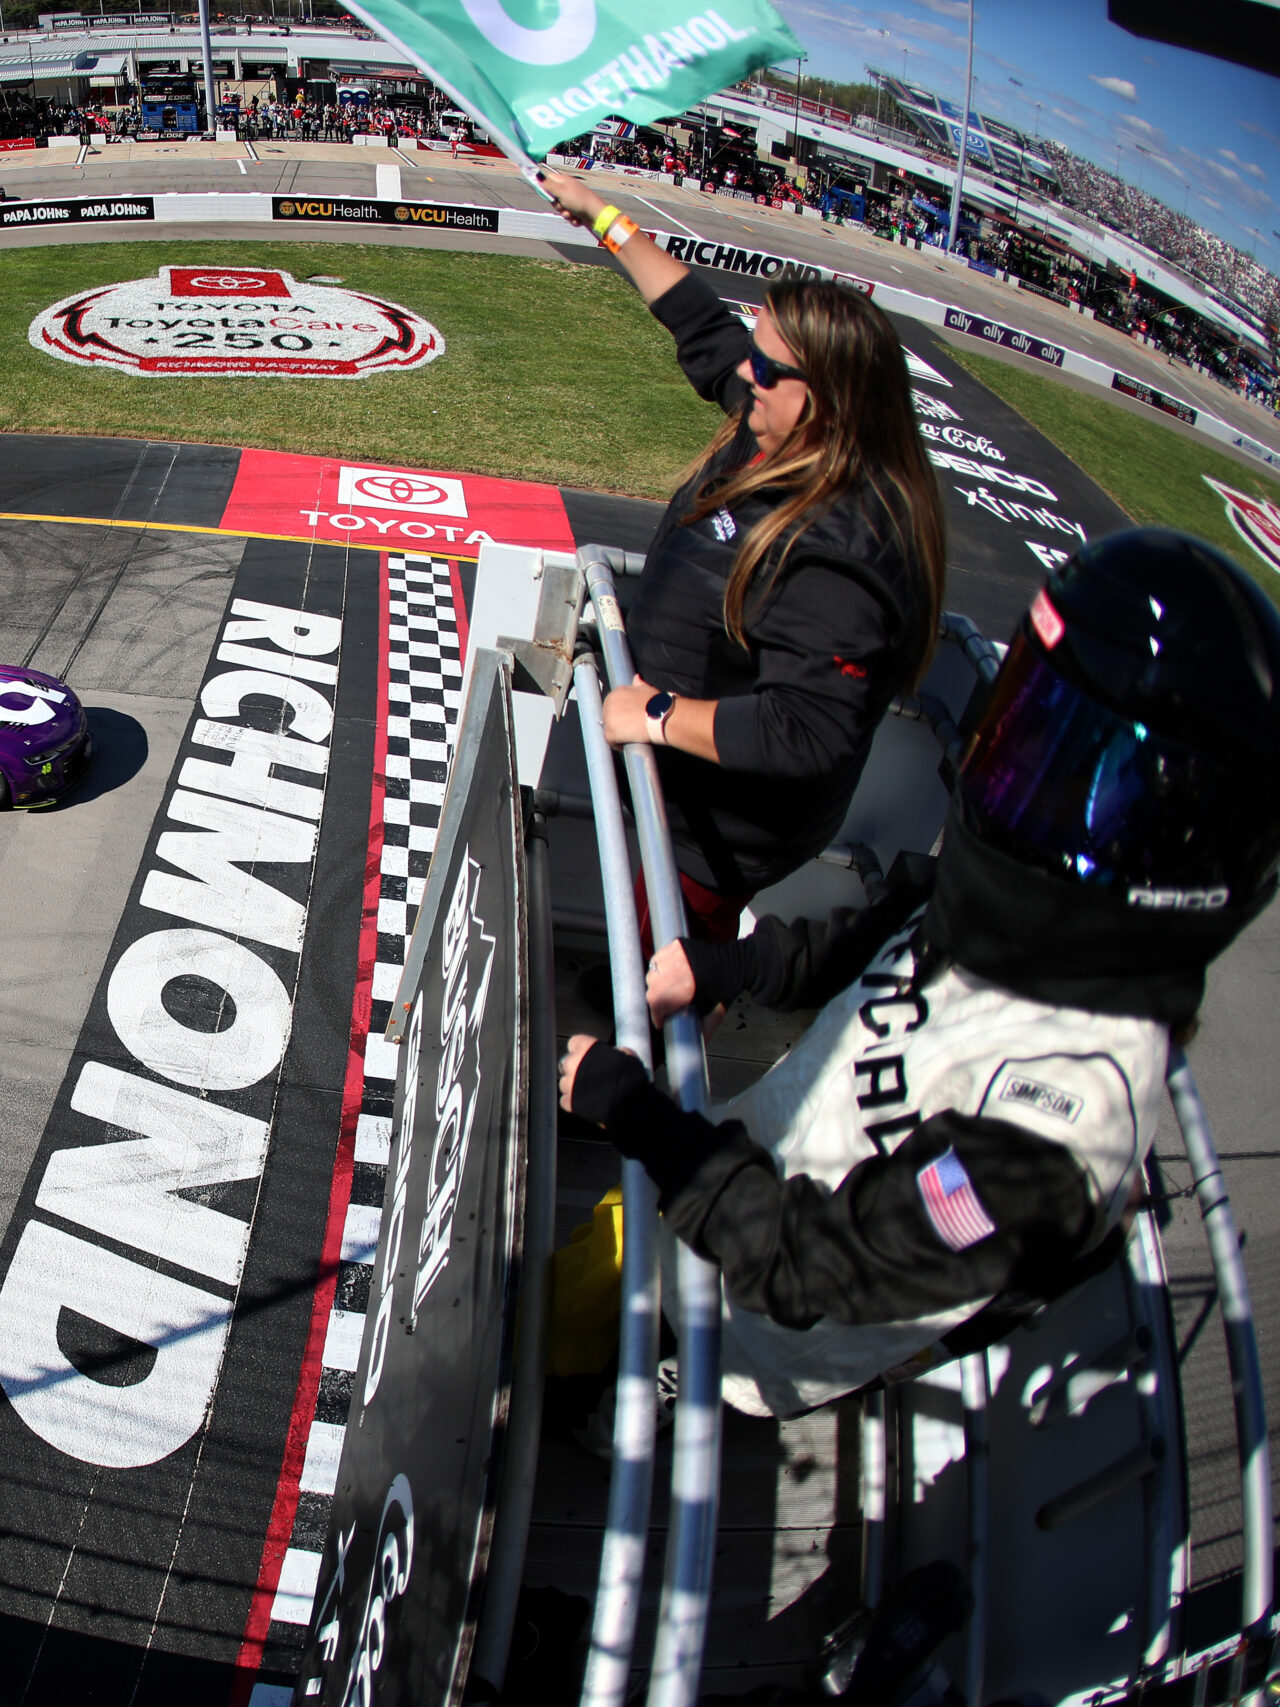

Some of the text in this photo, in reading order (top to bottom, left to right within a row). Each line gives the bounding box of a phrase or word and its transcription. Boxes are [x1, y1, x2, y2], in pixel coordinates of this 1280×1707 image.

[526, 9, 749, 129] BIOETHANOL
[3, 208, 69, 223] PAPA JOHNS
[81, 203, 147, 217] PAPA JOHNS
[666, 236, 822, 282] RICHMOND
[152, 302, 316, 314] TOYOTA
[104, 316, 380, 334] ToyotaCare
[950, 312, 972, 332] ally
[173, 332, 314, 352] 250
[983, 324, 1005, 343] ally
[1011, 335, 1032, 353] ally
[156, 358, 339, 372] RICHMOND RACEWAY
[1041, 346, 1061, 364] ally
[919, 422, 1006, 462] a-Cola
[299, 509, 496, 545] TOYOTA
[1128, 887, 1230, 910] GEICO
[411, 842, 470, 1320] BUSCH
[1007, 1080, 1075, 1117] SIMPSON
[363, 989, 425, 1407] GEICO
